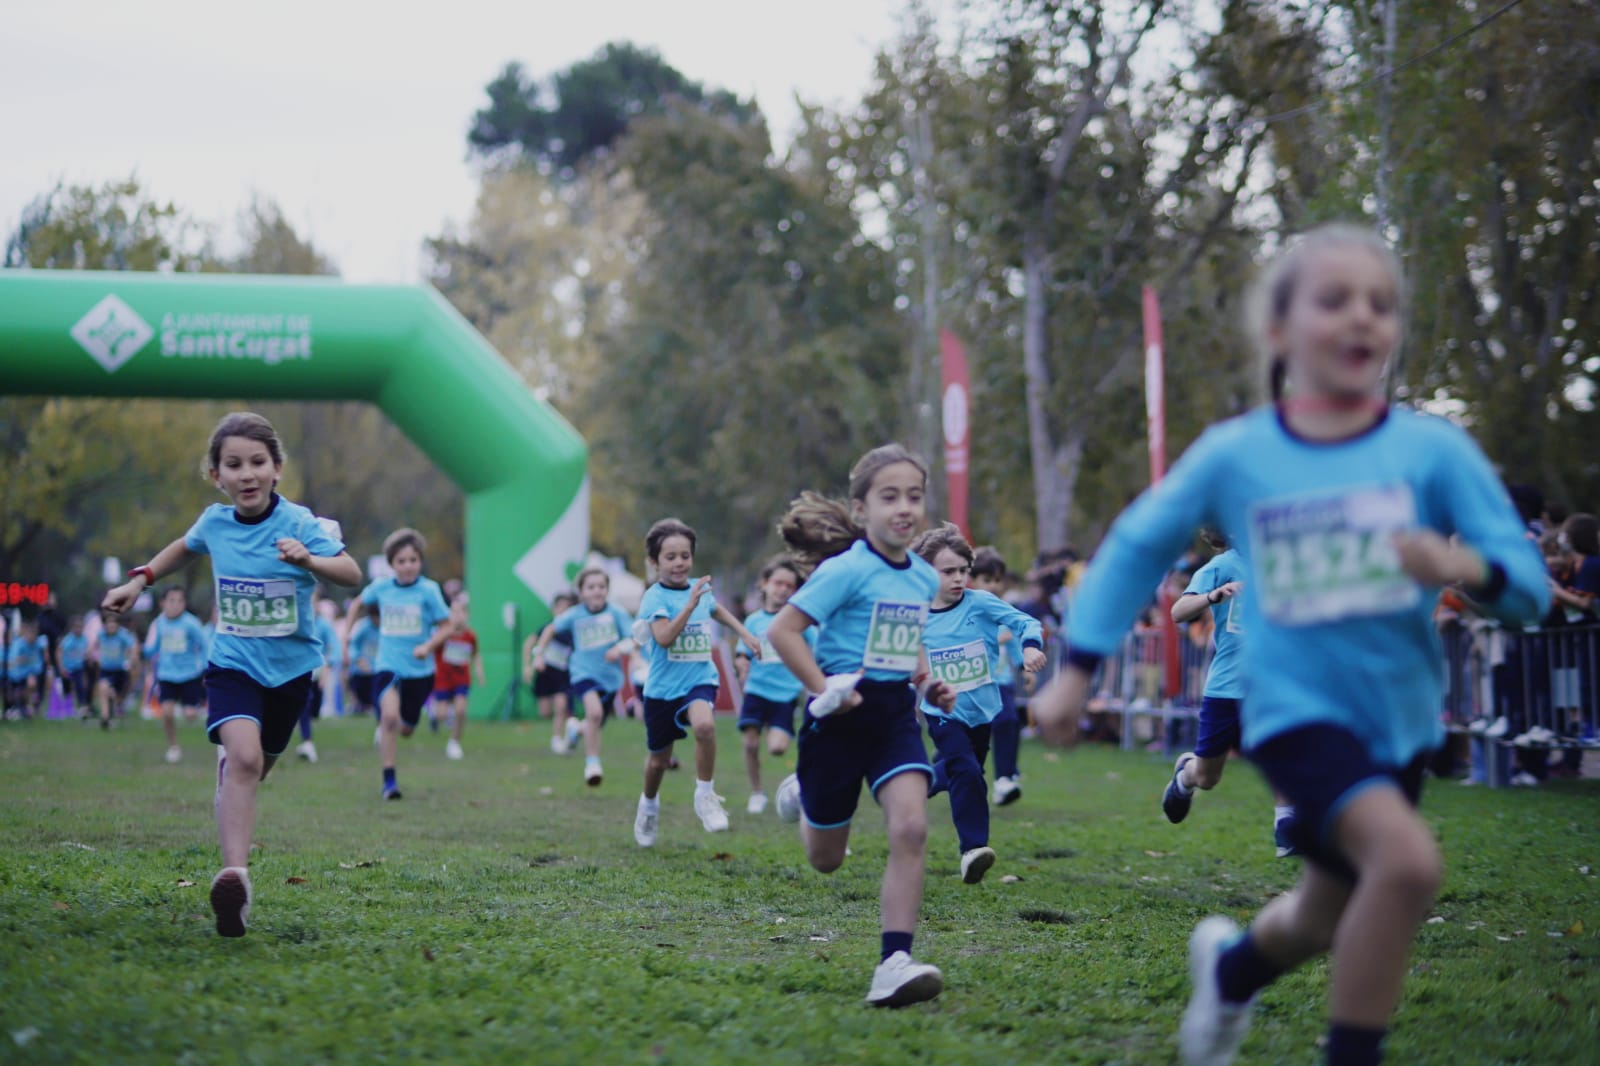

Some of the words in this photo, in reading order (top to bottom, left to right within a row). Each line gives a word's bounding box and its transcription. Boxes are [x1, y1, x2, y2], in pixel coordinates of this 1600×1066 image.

[236, 583, 263, 594] Cros
[222, 597, 289, 621] 1018
[875, 624, 921, 652] 102
[942, 650, 966, 659] Cros
[934, 657, 984, 682] 1029
